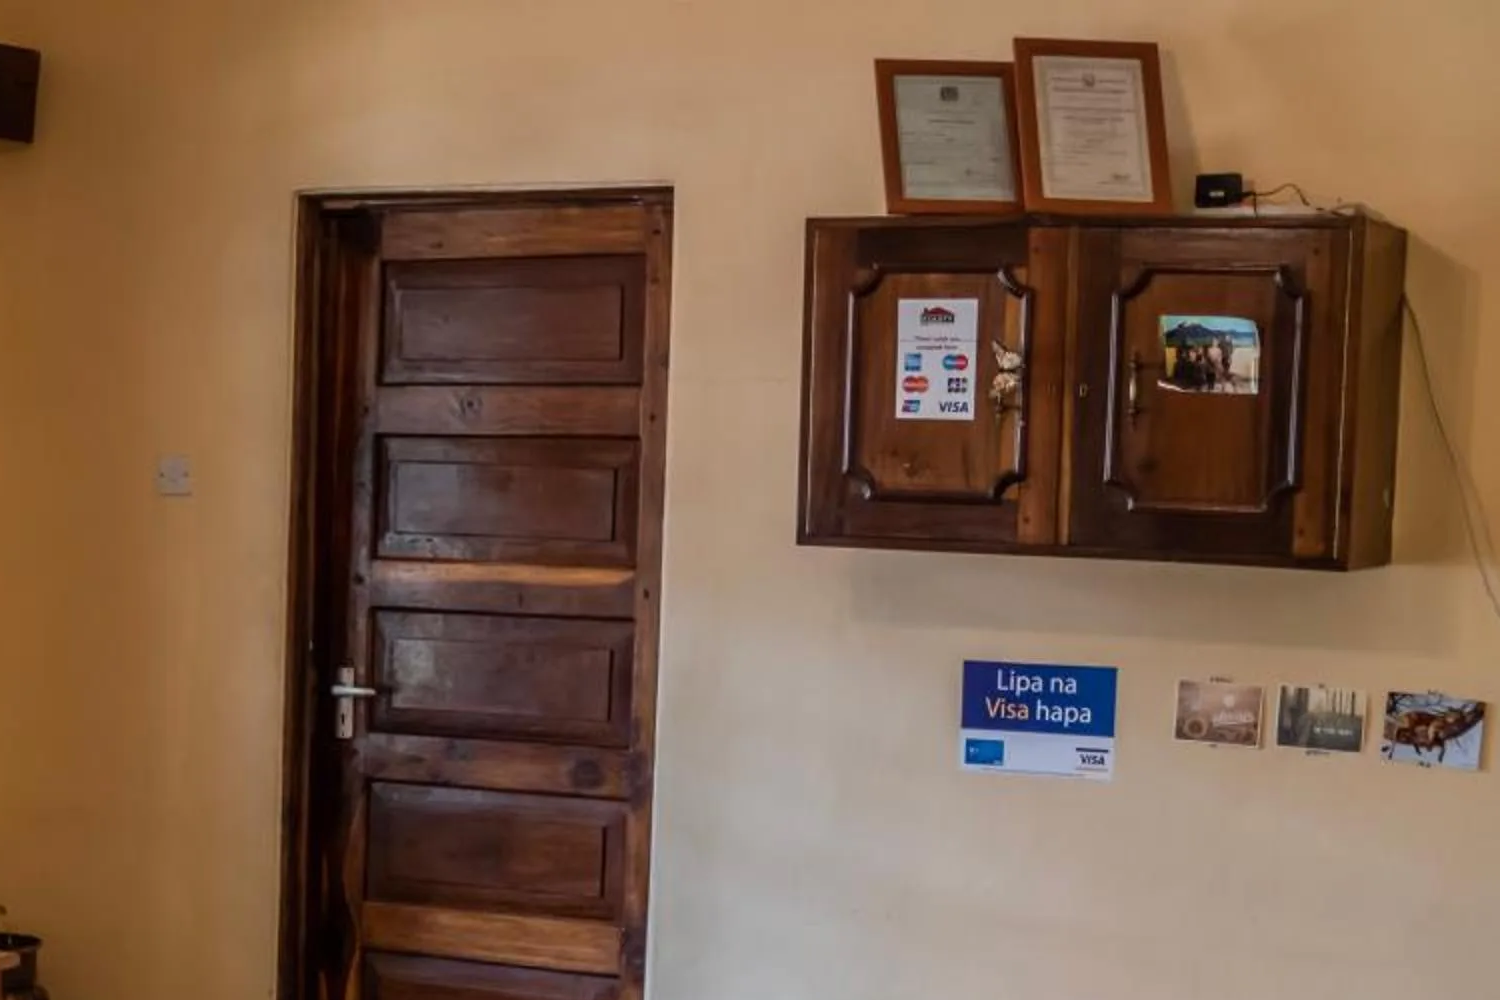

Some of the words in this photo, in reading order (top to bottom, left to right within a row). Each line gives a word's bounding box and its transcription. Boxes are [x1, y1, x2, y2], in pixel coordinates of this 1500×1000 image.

[939, 401, 969, 413] VISA
[997, 669, 1043, 696] Lipa
[1050, 676, 1077, 693] na
[985, 696, 1029, 720] Visa
[1035, 699, 1092, 727] hapa
[1079, 754, 1105, 766] VISA
